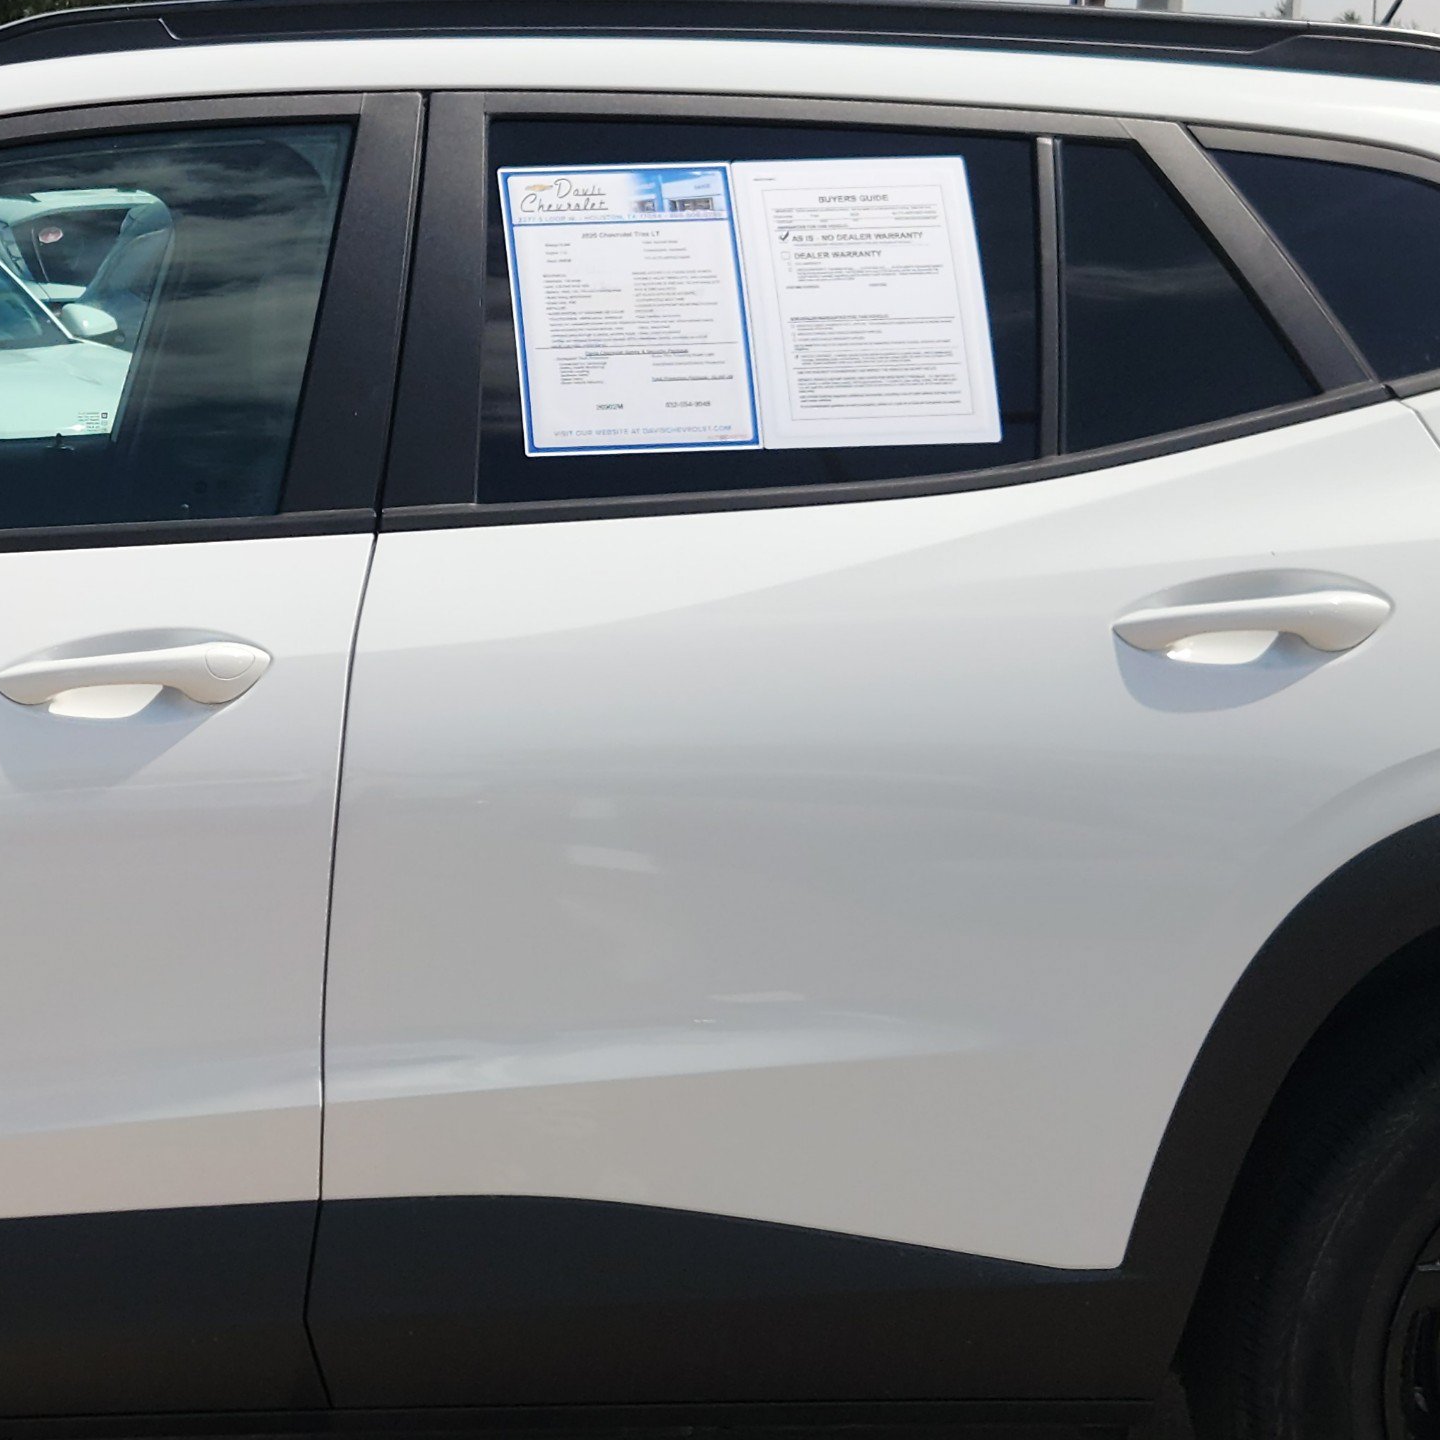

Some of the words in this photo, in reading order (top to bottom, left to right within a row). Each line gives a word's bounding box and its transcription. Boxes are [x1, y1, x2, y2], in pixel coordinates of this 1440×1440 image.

[554, 178, 606, 198] Davis
[520, 193, 608, 213] Chevrolet
[832, 250, 881, 258] WARRANTY
